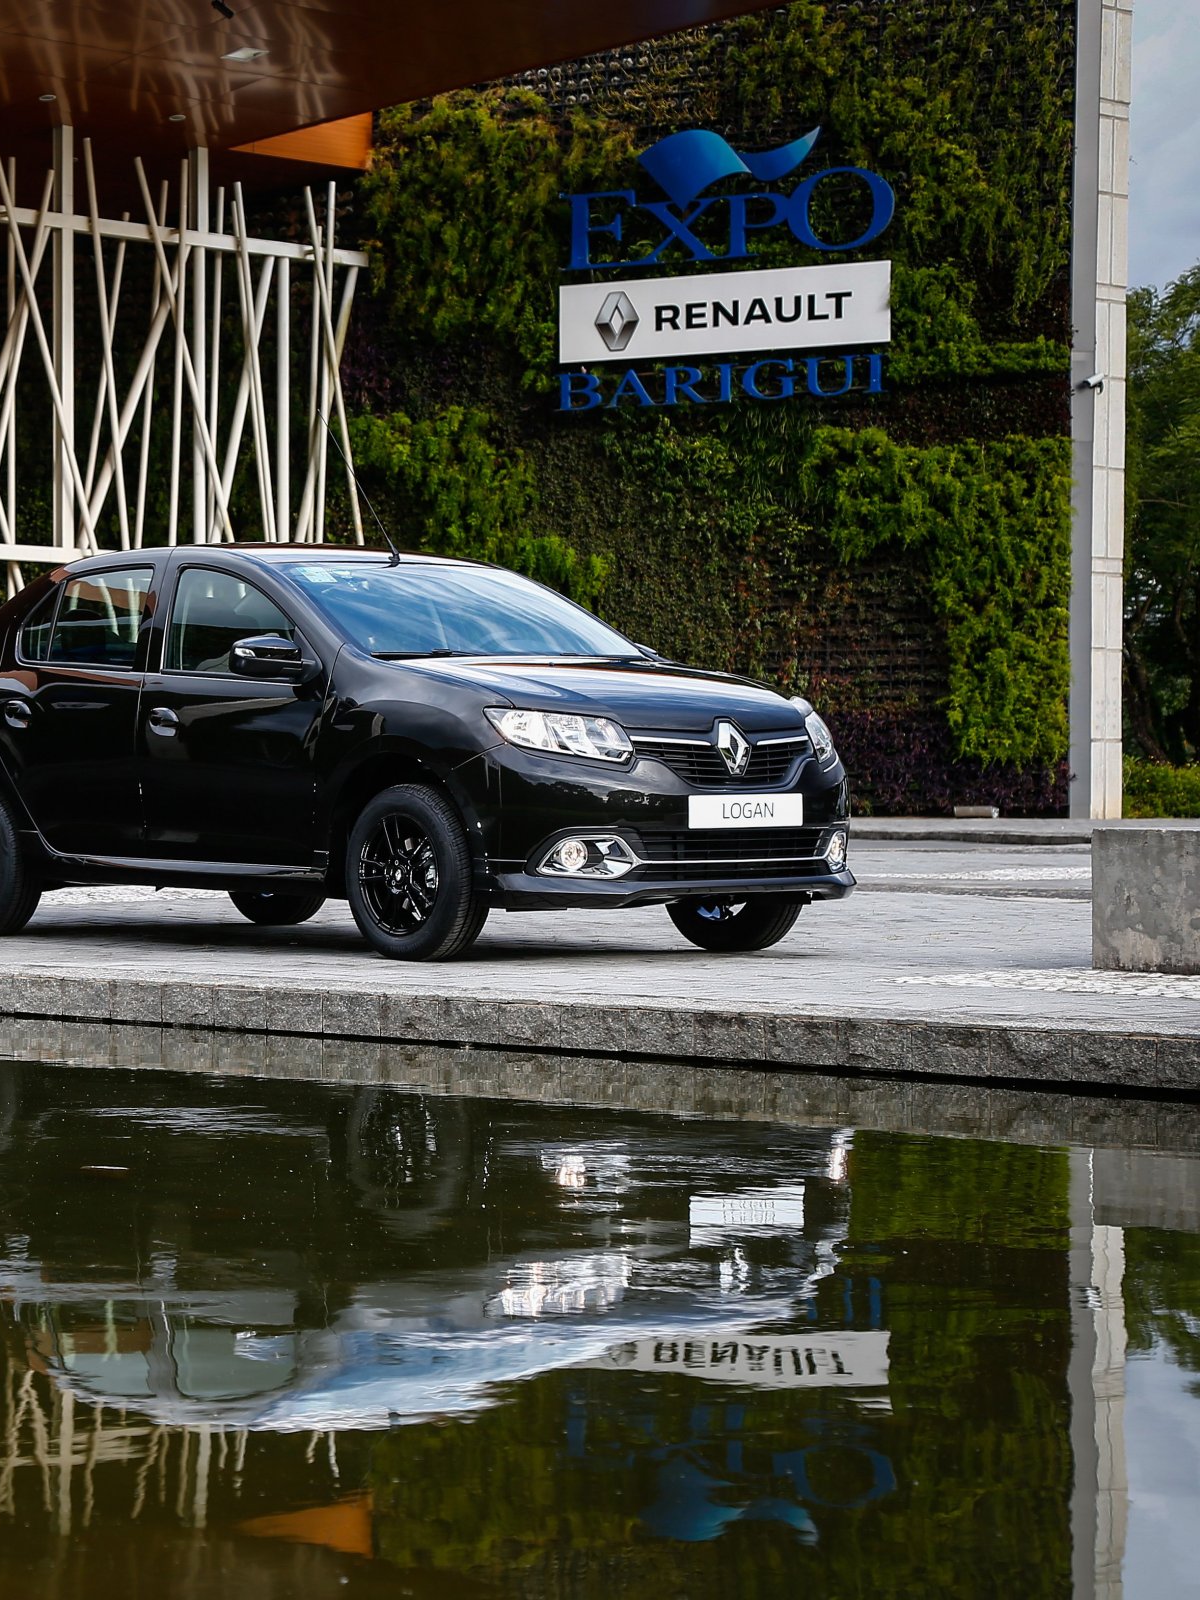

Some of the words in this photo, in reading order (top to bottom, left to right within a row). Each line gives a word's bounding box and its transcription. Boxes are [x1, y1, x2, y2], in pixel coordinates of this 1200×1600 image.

[560, 166, 895, 271] EXPO
[654, 291, 852, 332] RENAULT
[557, 353, 888, 411] BARIGUI
[722, 802, 774, 819] LOGAN
